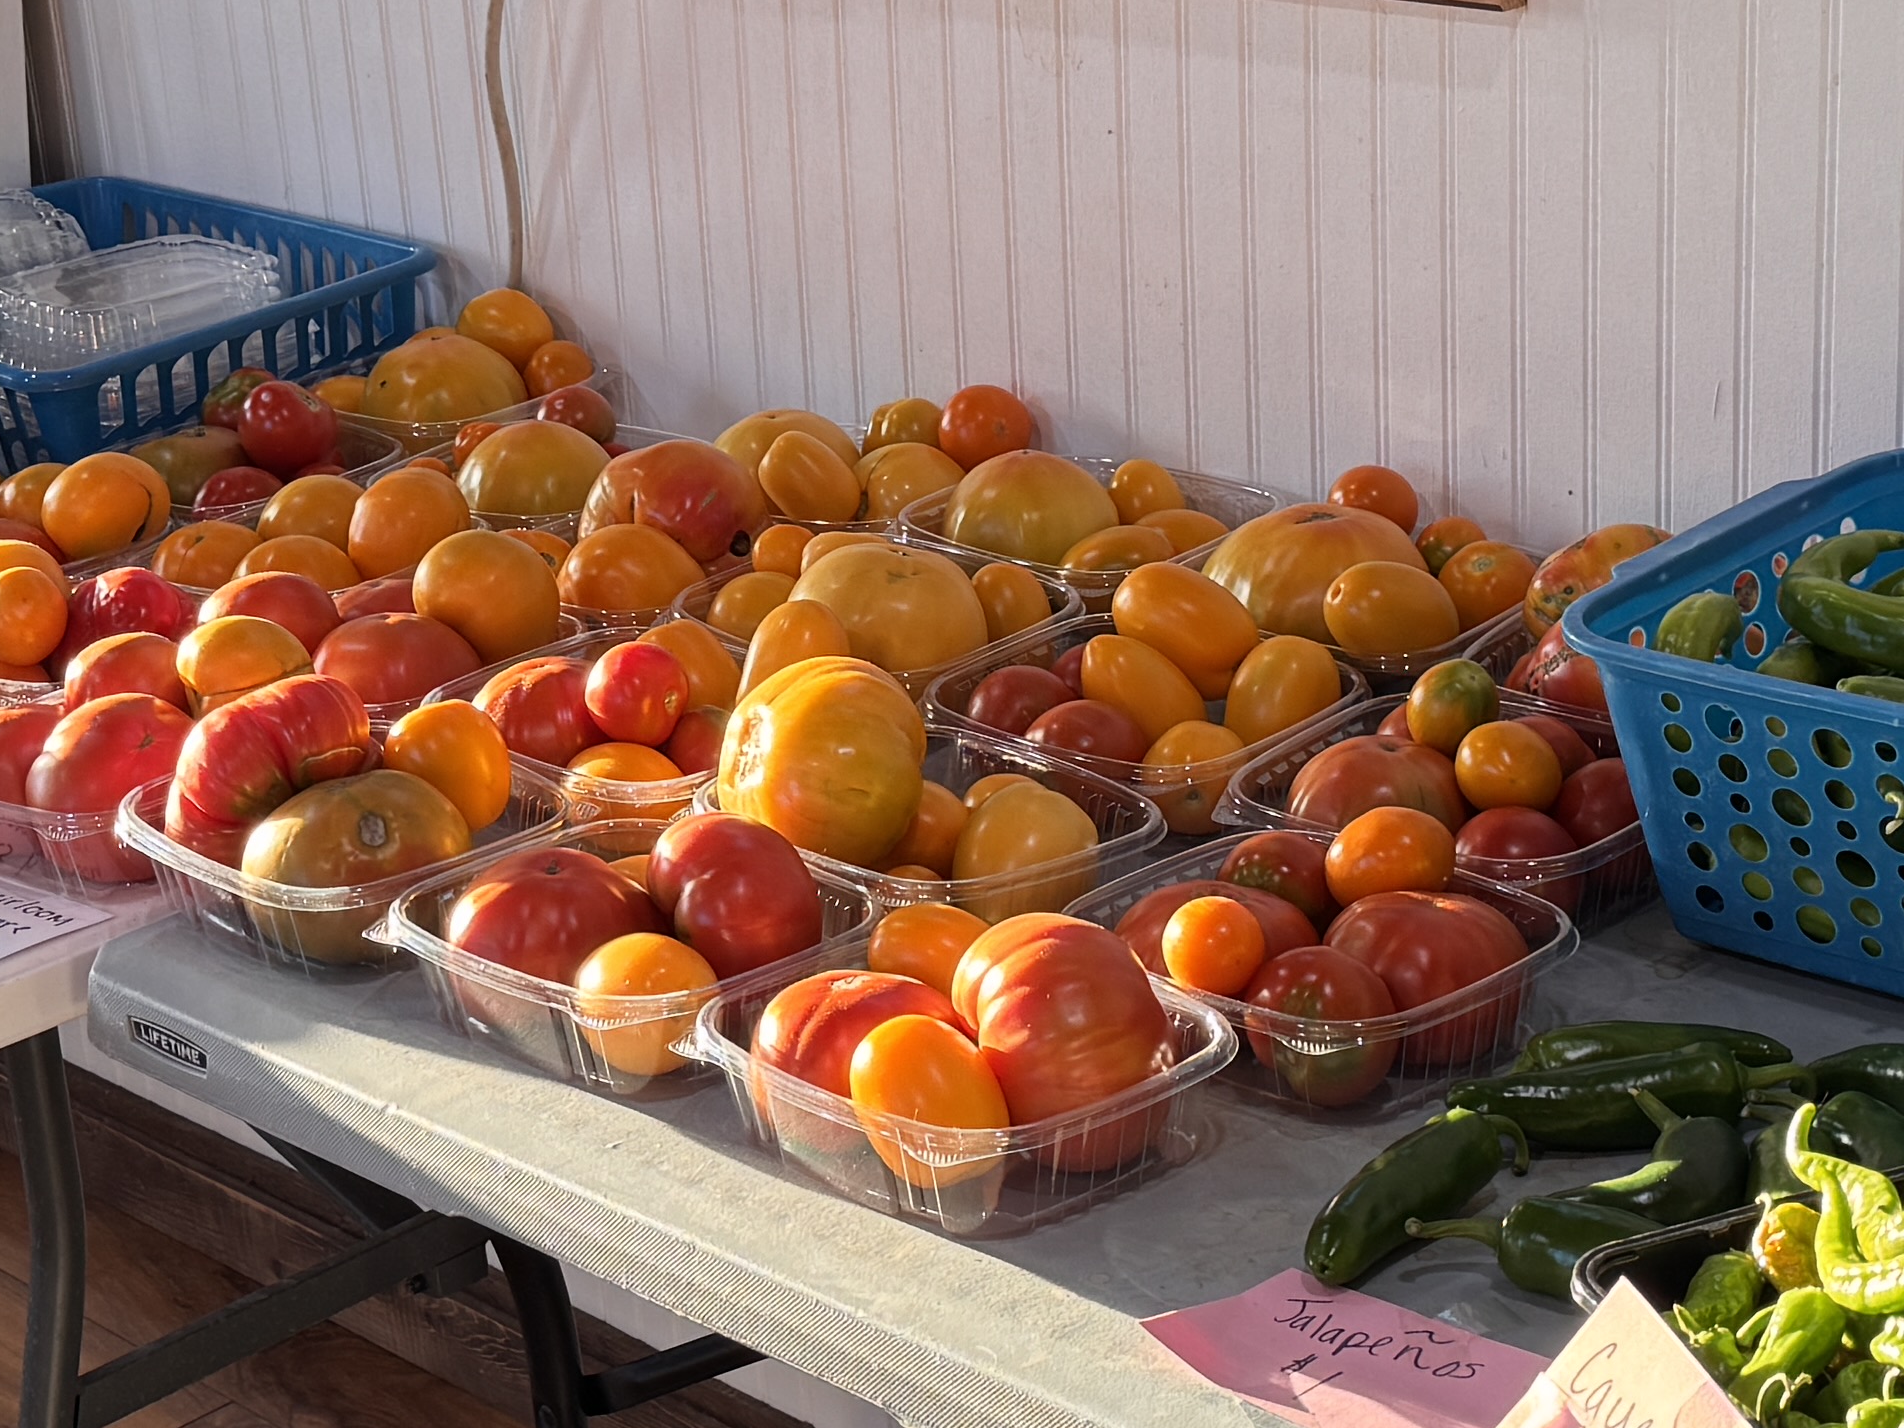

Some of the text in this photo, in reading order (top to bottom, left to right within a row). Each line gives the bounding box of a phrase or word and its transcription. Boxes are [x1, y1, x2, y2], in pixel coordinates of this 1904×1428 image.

[140, 1024, 200, 1065] LIFETIME
[1273, 1298, 1486, 1380] Jalapeños
[1280, 1353, 1344, 1401] $1
